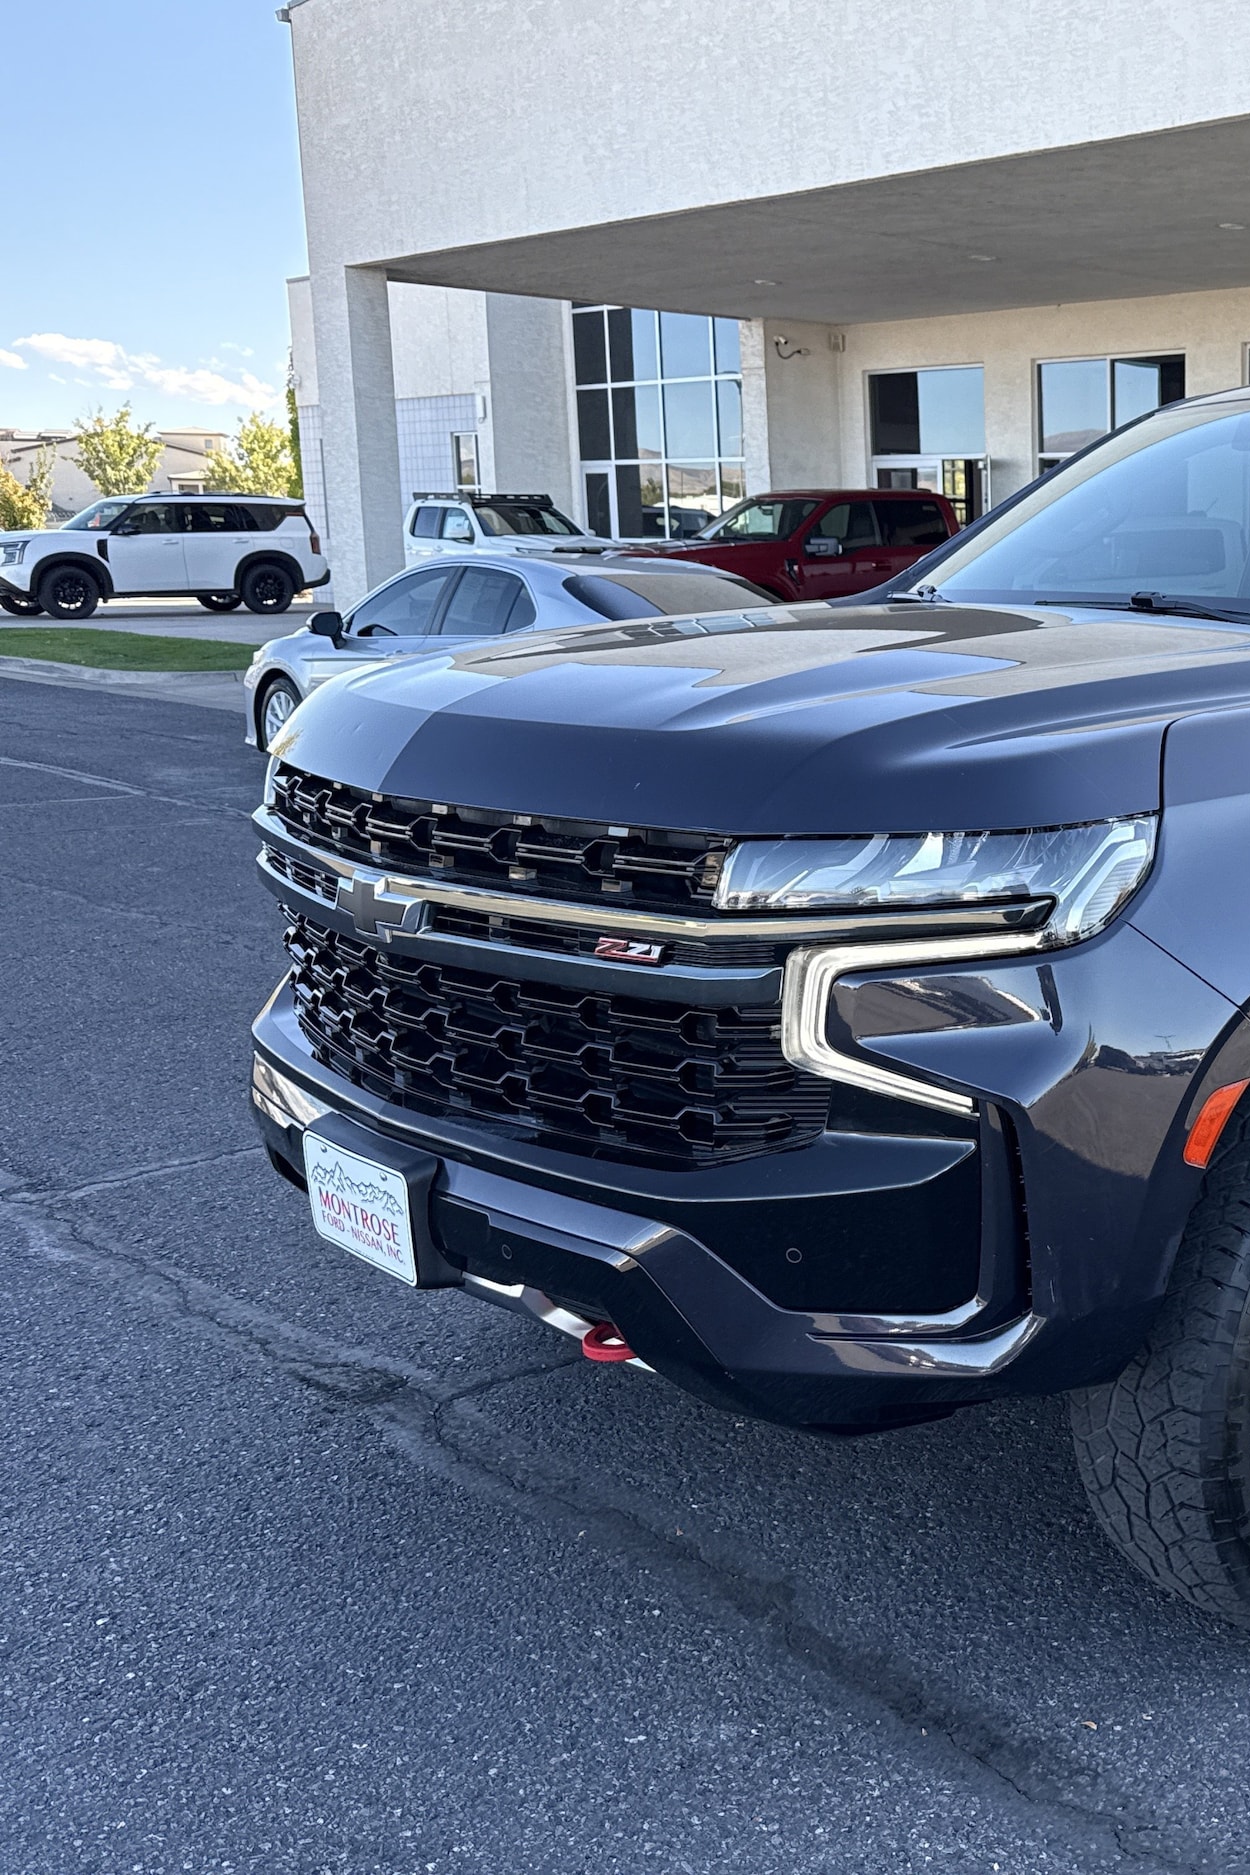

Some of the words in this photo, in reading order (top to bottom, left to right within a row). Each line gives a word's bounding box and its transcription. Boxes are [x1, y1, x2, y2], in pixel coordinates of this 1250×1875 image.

[594, 937, 664, 963] Z71
[318, 1186, 401, 1246] MONTROSE
[322, 1210, 345, 1233] FORD
[351, 1226, 387, 1257] NISSAN,
[388, 1245, 406, 1265] INC.
